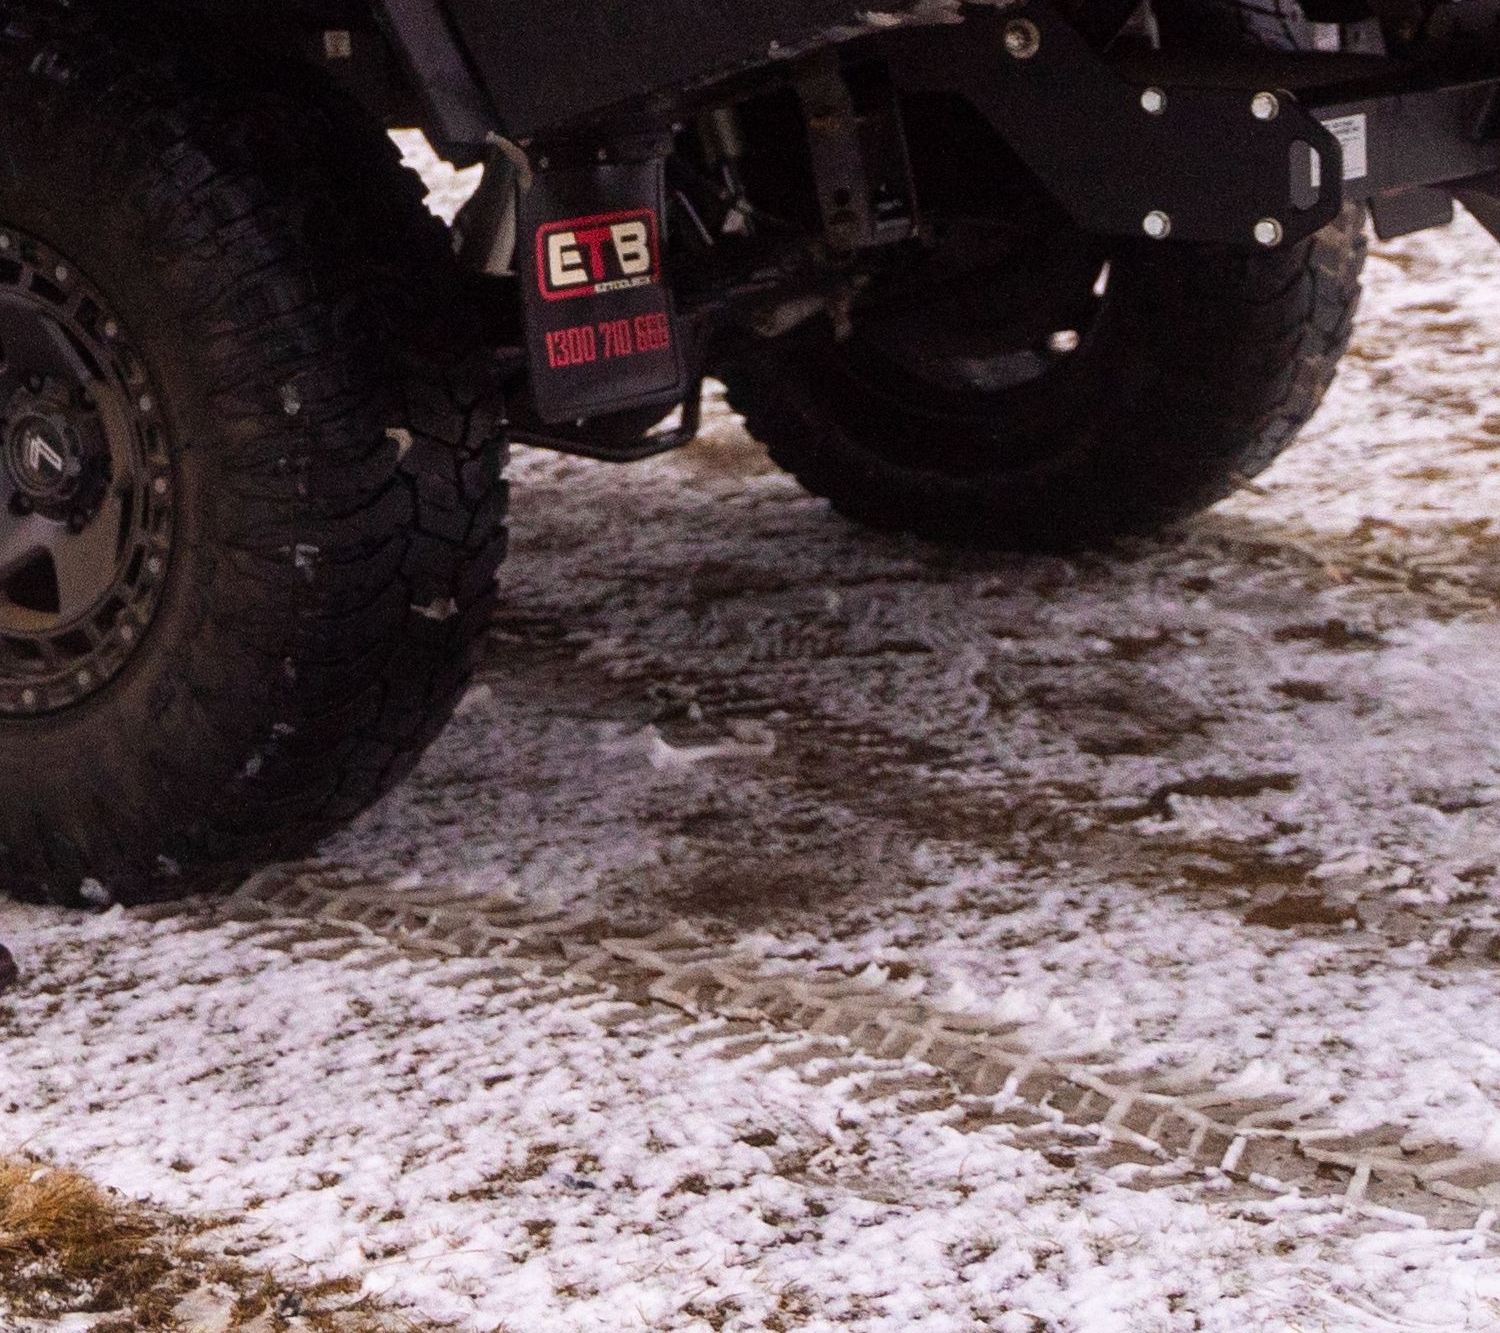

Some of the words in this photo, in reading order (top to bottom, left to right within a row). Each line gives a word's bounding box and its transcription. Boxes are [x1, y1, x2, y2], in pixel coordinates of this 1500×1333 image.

[548, 221, 651, 287] ETB
[545, 325, 597, 369] 1300
[599, 319, 632, 359] 710
